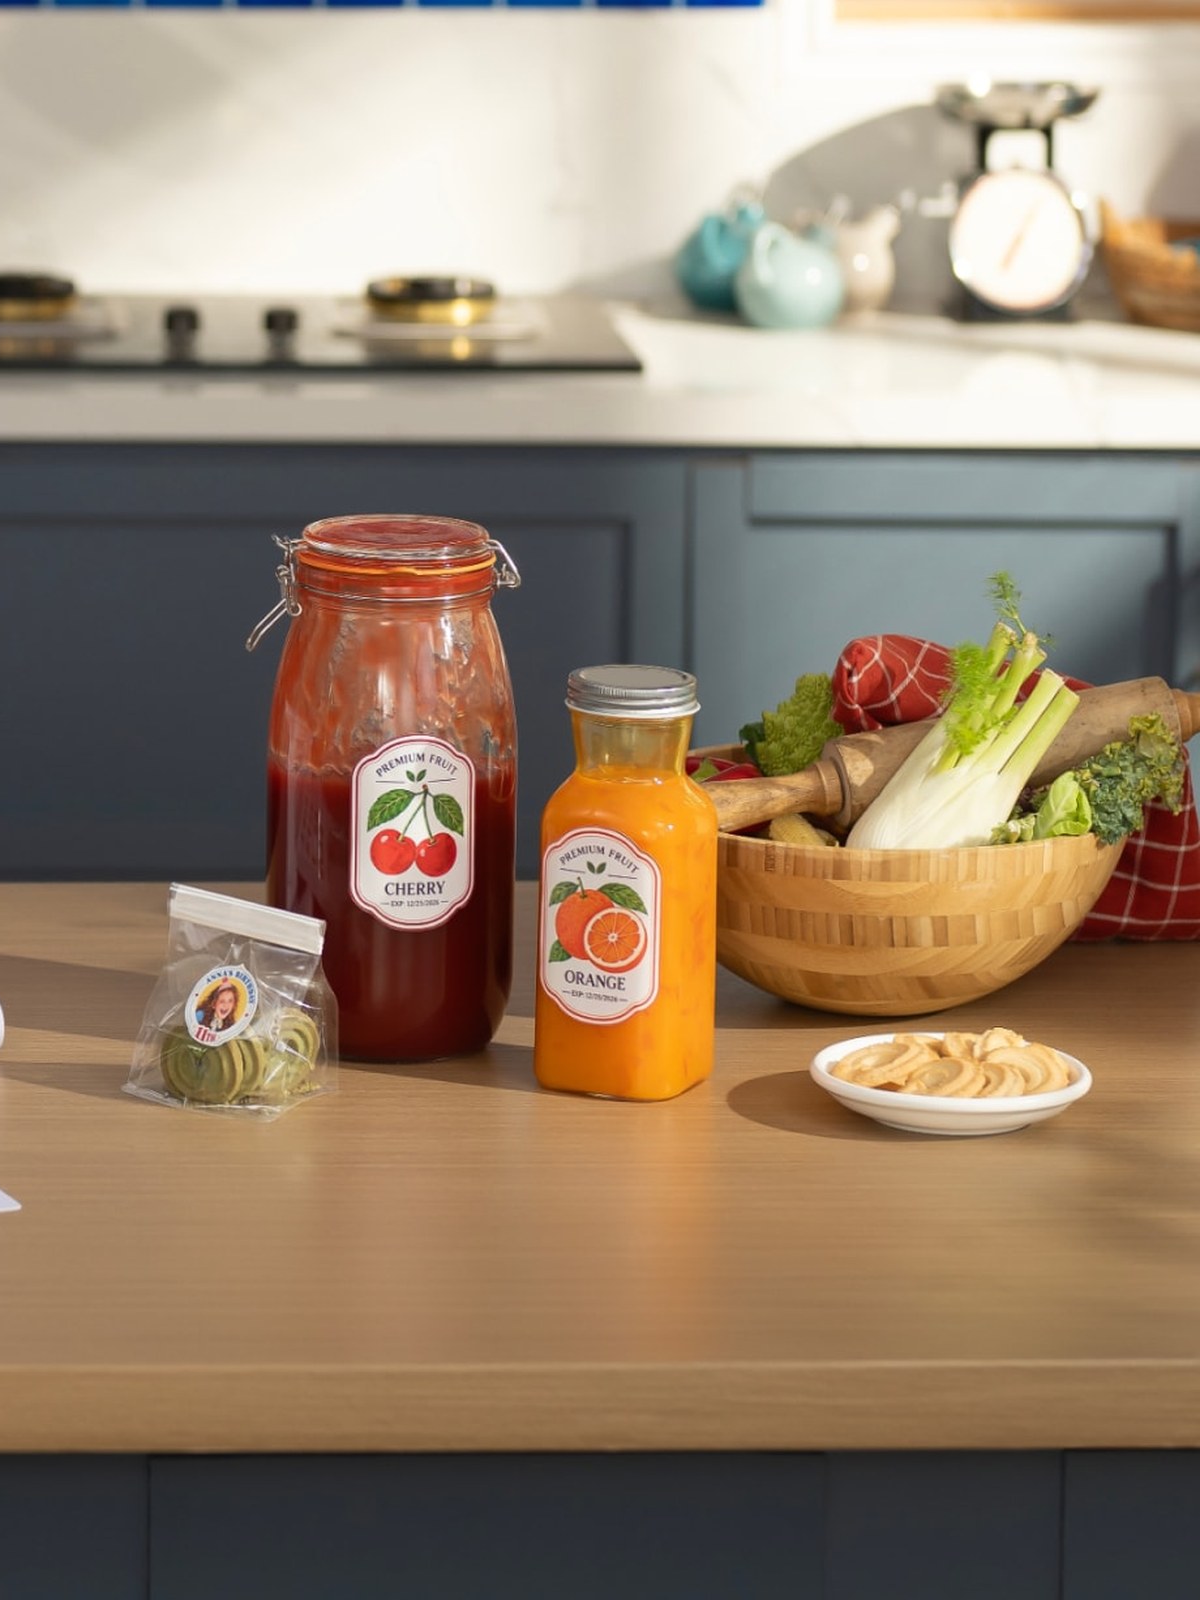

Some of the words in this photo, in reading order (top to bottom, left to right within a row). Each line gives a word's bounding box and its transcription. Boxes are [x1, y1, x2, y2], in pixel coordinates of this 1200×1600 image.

[375, 752, 425, 778] PREMIUM
[429, 754, 458, 776] FRUIT
[559, 844, 605, 865] PREMIUM
[608, 849, 640, 873] FRUIT
[384, 880, 445, 896] CHERRY
[564, 969, 626, 991] ORANGE
